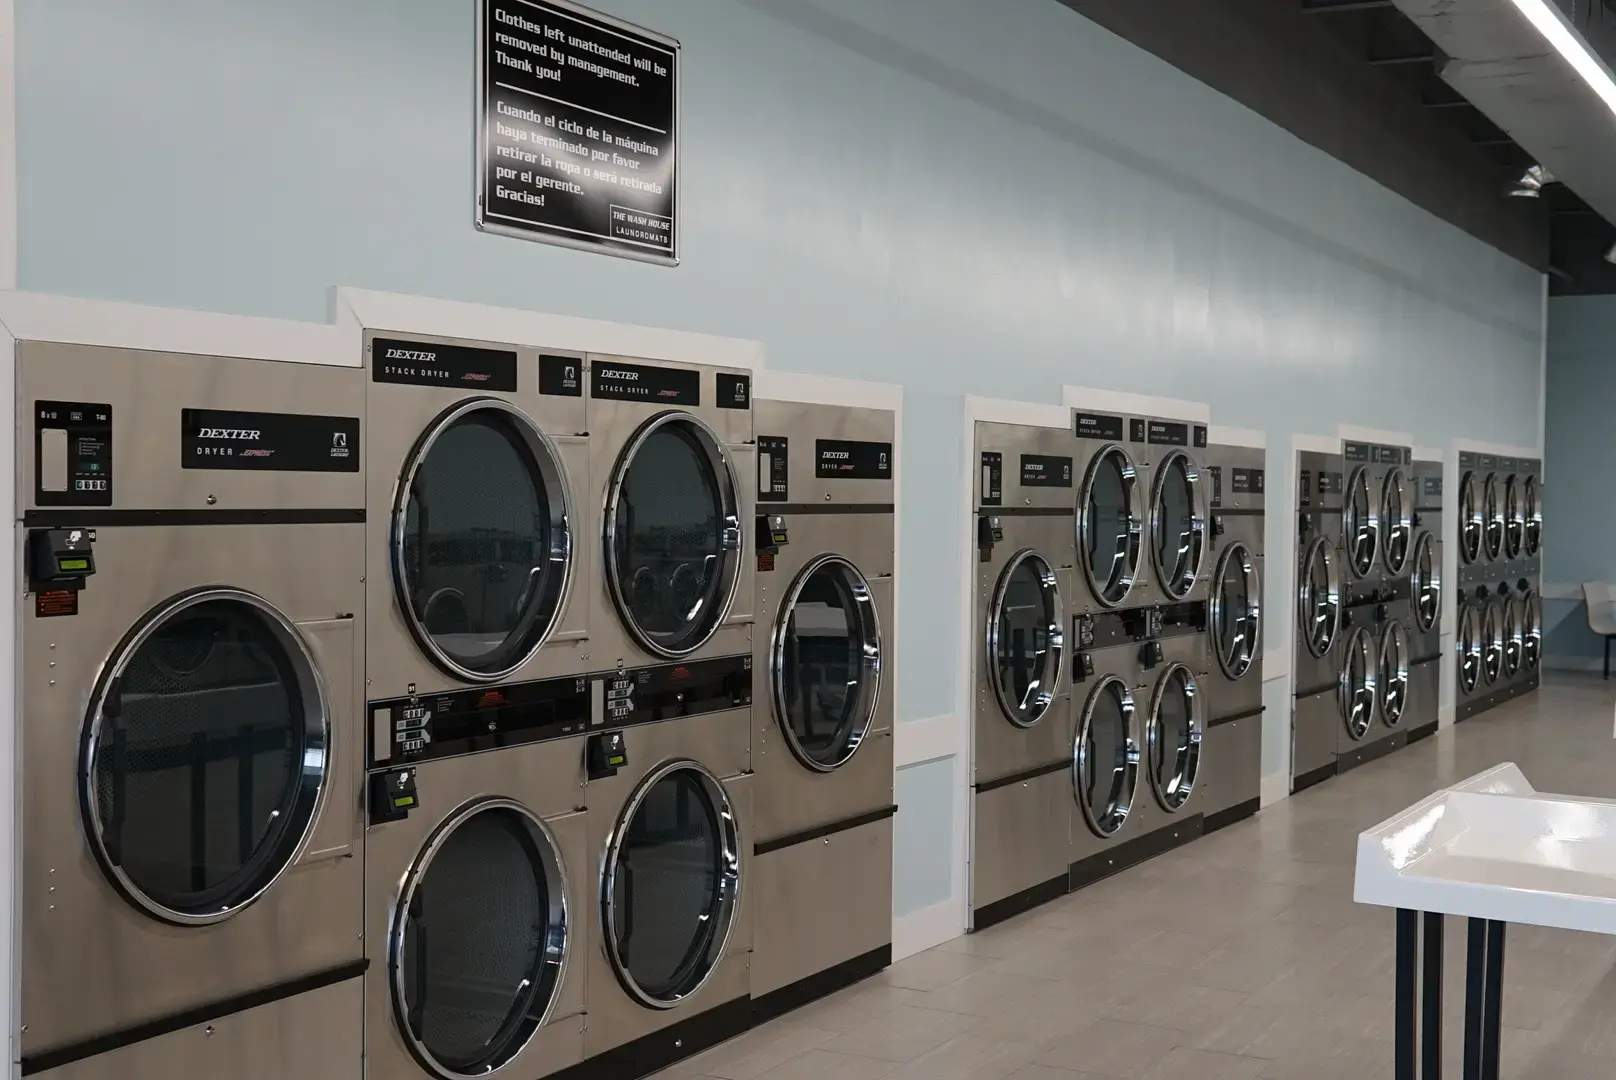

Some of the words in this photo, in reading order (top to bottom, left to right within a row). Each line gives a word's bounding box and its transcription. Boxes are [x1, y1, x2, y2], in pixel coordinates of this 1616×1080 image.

[495, 8, 541, 34] Clothes
[544, 25, 565, 43] left
[568, 36, 631, 65] unattended
[633, 57, 651, 72] will
[653, 63, 667, 77] be
[495, 32, 547, 57] removed
[550, 47, 565, 66] by
[567, 56, 640, 87] management.
[495, 50, 533, 73] Thank
[535, 64, 562, 82] you!
[496, 100, 541, 124] Cuando
[544, 115, 555, 127] el
[558, 118, 583, 135] ciclo
[586, 126, 600, 140] de
[602, 129, 612, 144] la
[615, 135, 659, 156] máquina
[496, 121, 527, 142] haya
[531, 131, 589, 156] terminado
[591, 149, 610, 163] por
[612, 152, 640, 170] favor
[496, 145, 538, 164] retirar
[541, 153, 552, 168] la
[555, 158, 580, 176] ropa
[583, 167, 591, 177] o
[593, 170, 617, 184] será
[620, 175, 662, 195] retirada
[496, 166, 517, 180] por
[521, 171, 532, 184] el
[535, 174, 584, 195] gerente.
[496, 184, 545, 206] Gracias!
[613, 211, 626, 221] THE
[627, 214, 647, 226] WASH
[647, 219, 670, 231] HOUSE
[616, 226, 668, 243] LAUNDROMATS
[385, 348, 436, 361] DEXTER
[385, 366, 415, 375] STACK
[421, 369, 449, 378] DRYER
[600, 369, 639, 380] DEXTER
[600, 384, 624, 393] STACK
[627, 387, 649, 395] DRYER
[198, 428, 261, 440] DEXTER
[197, 447, 233, 456] DRYER
[822, 451, 850, 459] DEXTER
